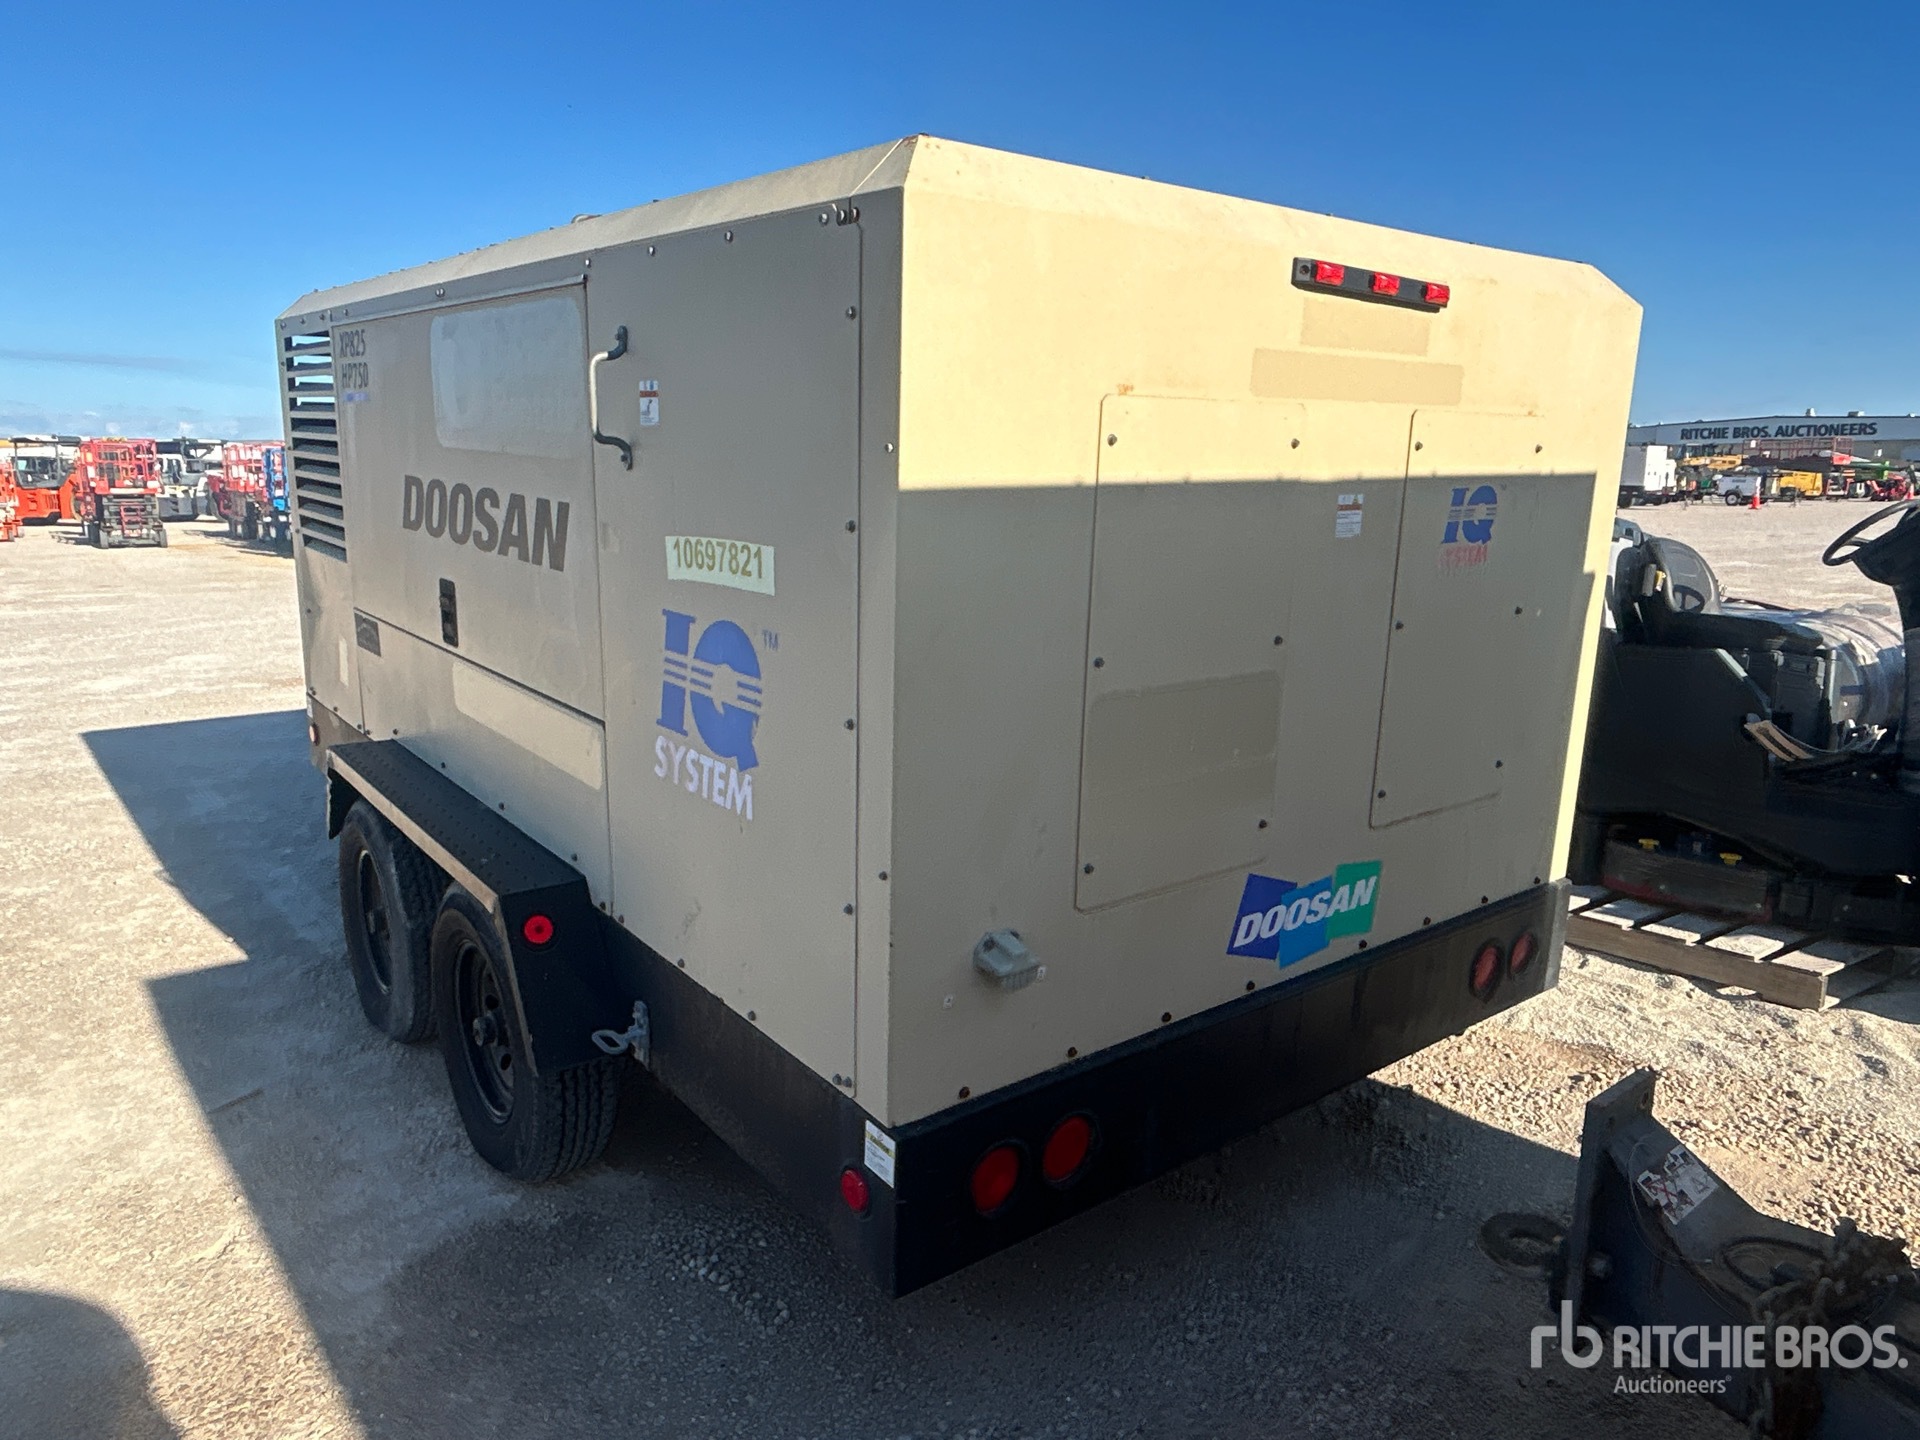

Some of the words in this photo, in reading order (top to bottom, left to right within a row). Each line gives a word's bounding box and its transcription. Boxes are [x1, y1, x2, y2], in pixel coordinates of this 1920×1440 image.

[341, 362, 369, 388] HP750
[1680, 426, 1730, 440] RITCHIE
[1733, 425, 1771, 439] BROS.
[1774, 422, 1878, 438] AUCTIONEERS
[402, 474, 570, 572] DOOSAN
[1441, 485, 1498, 545] IQ
[673, 537, 763, 579] 10697821
[656, 608, 762, 772] IQ
[654, 735, 754, 821] SYSTEM
[1233, 875, 1378, 948] DOOSAN
